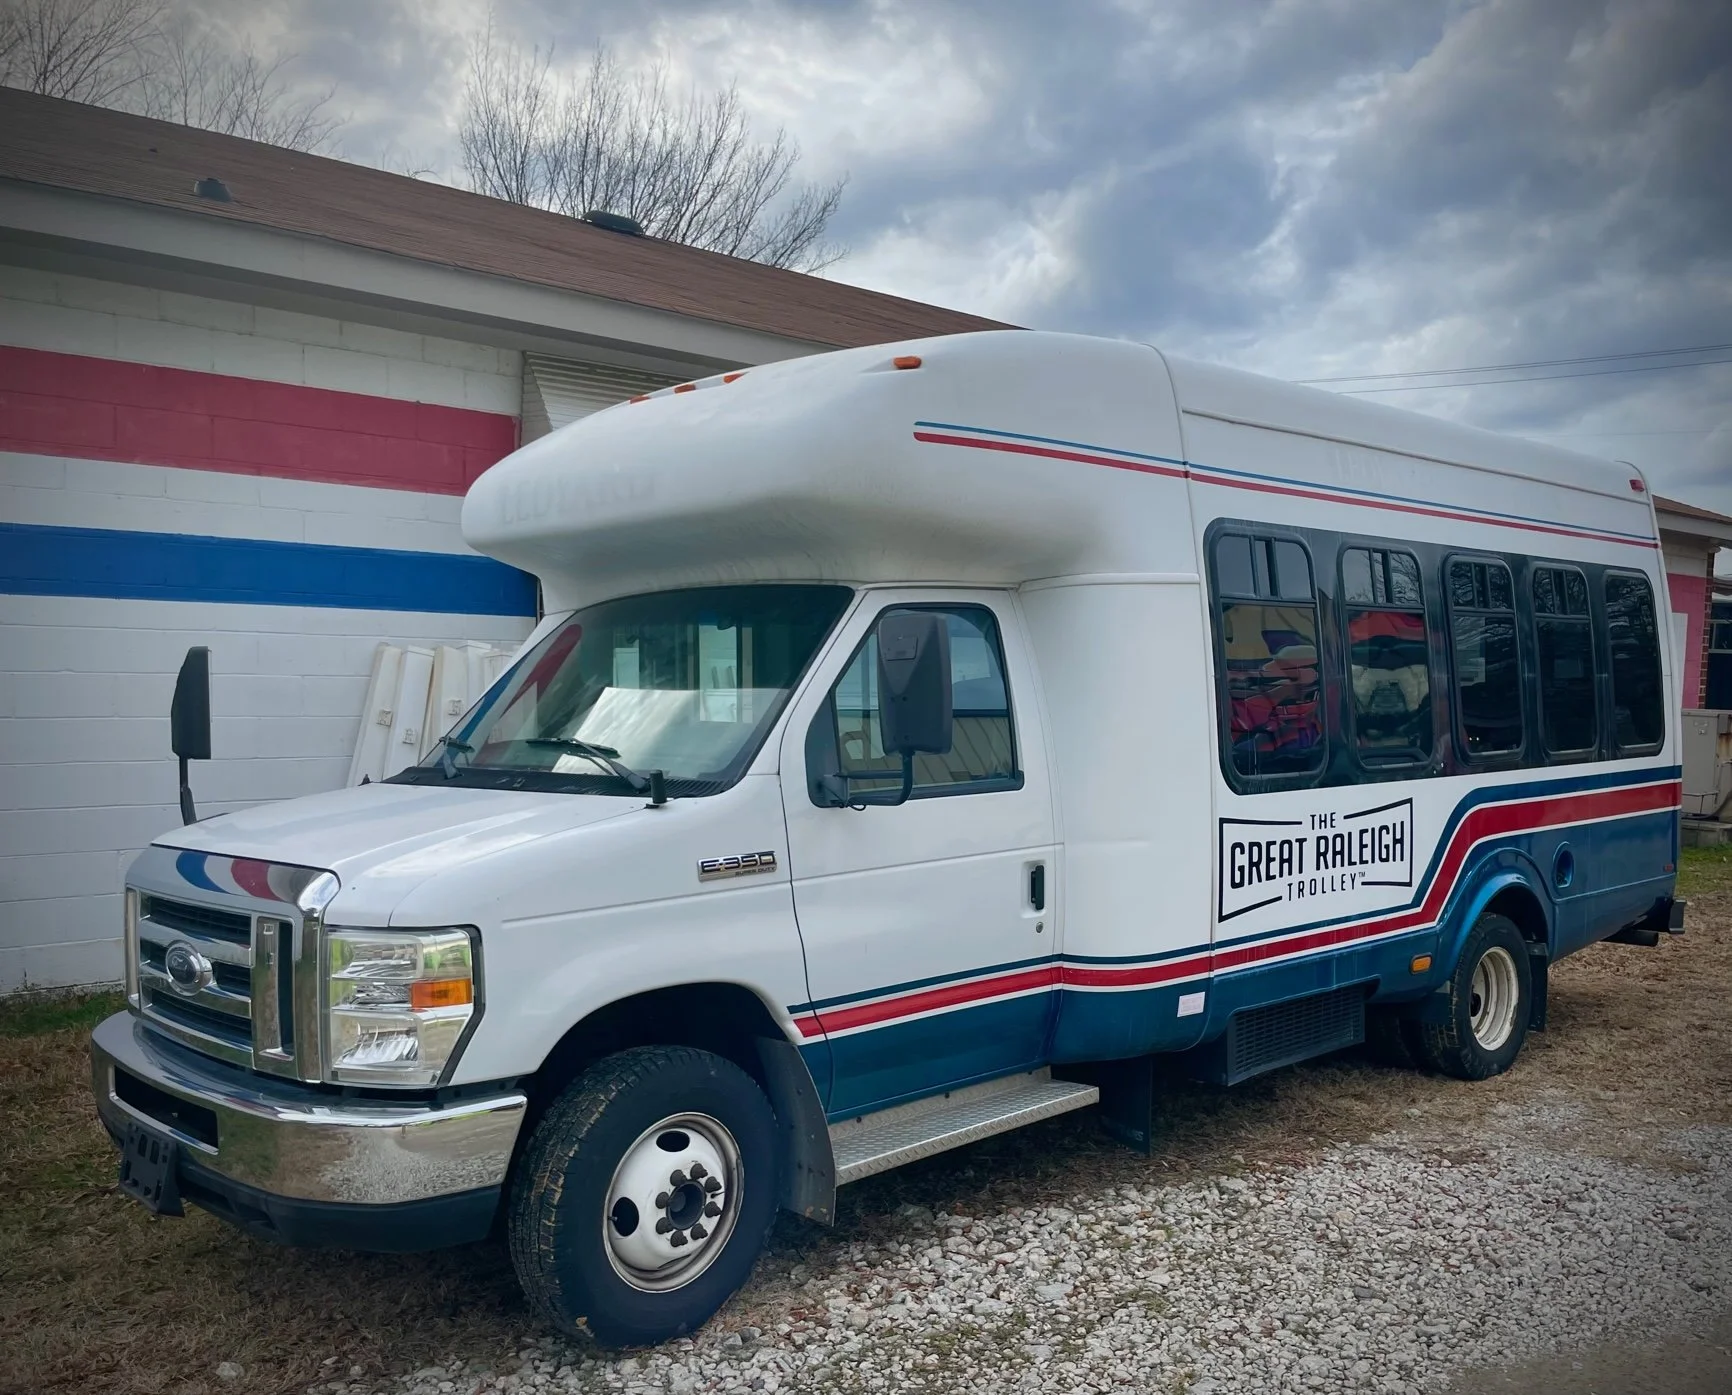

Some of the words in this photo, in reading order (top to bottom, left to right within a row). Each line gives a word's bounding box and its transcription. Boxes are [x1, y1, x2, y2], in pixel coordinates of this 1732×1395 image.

[1309, 812, 1336, 830] THE
[700, 854, 775, 873] E-350
[1230, 838, 1307, 889] GREAT
[1315, 821, 1405, 871] RALEIGH
[1287, 873, 1356, 901] TROLLEY
